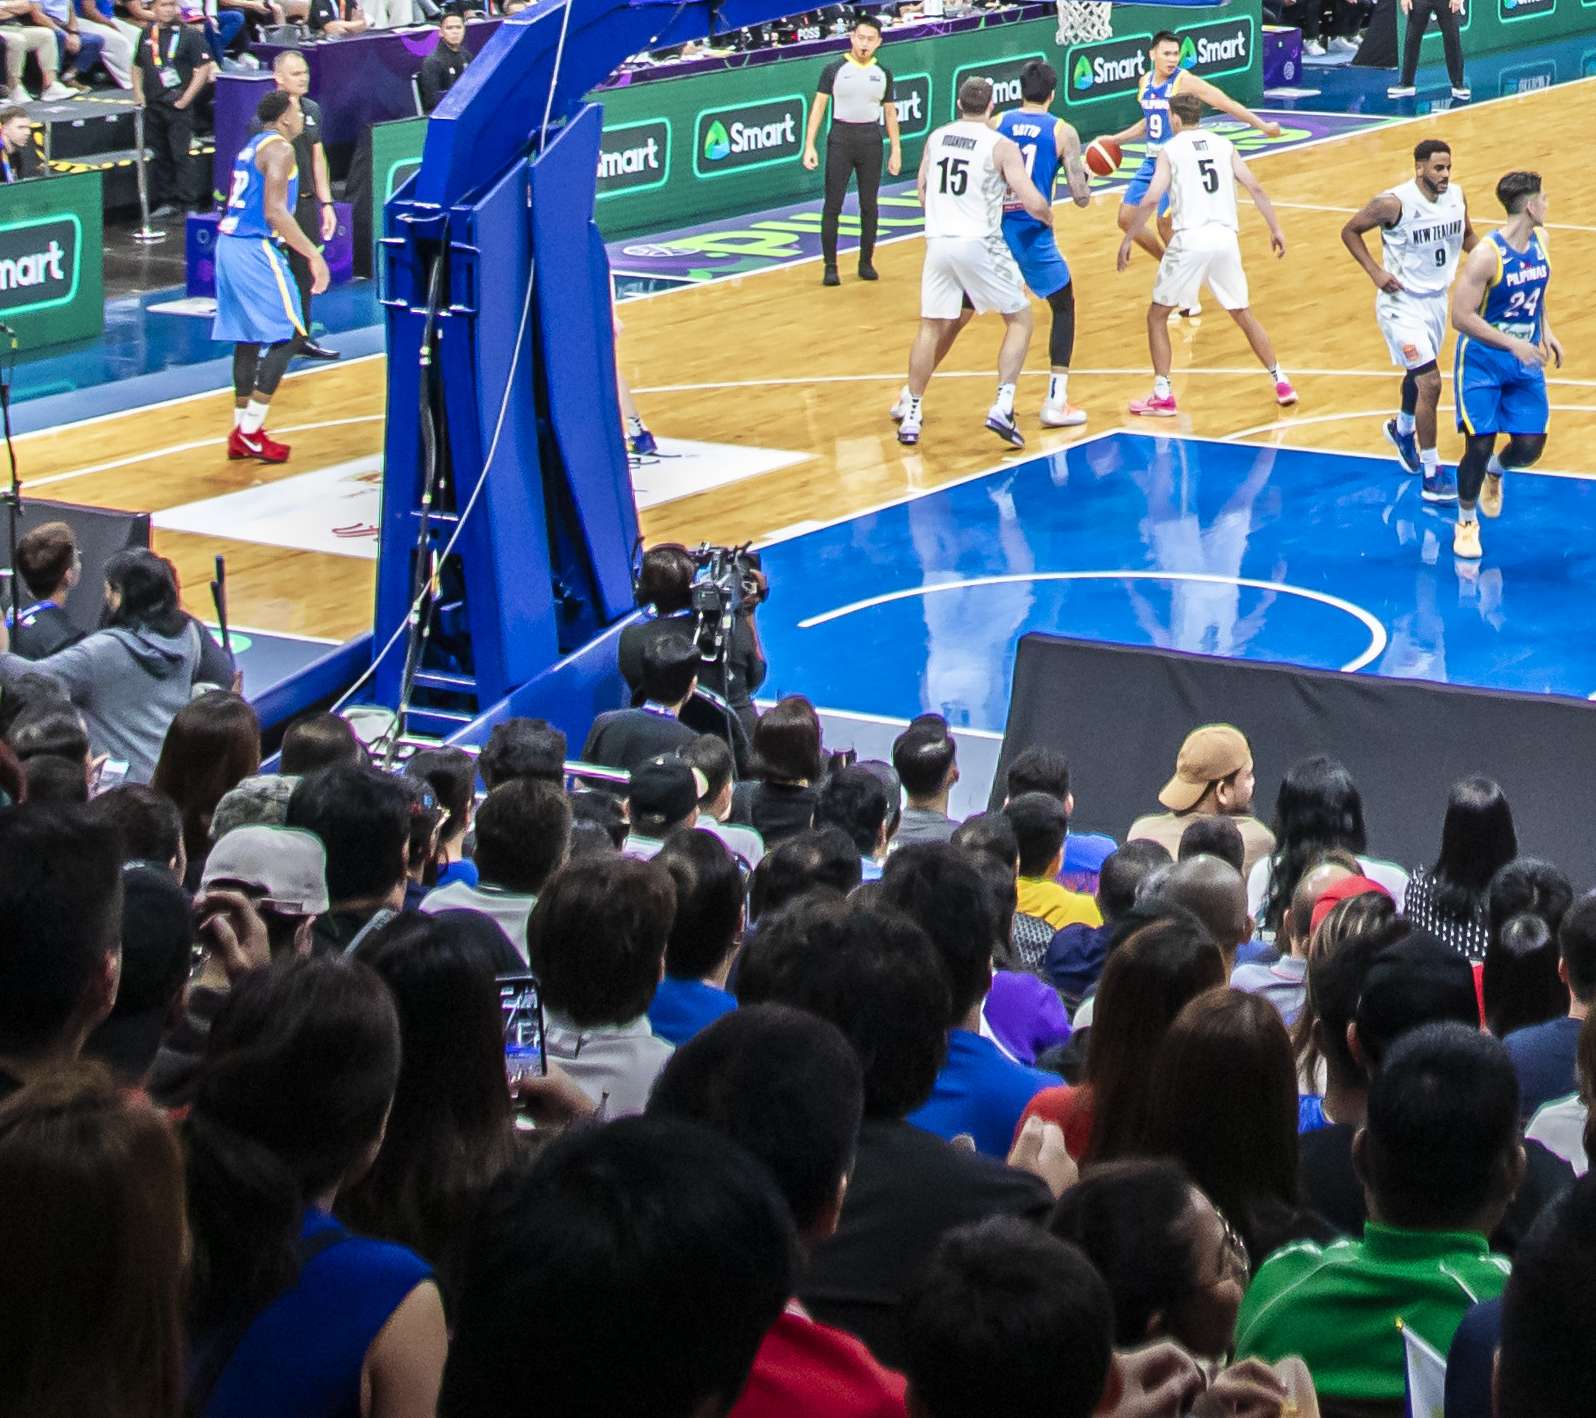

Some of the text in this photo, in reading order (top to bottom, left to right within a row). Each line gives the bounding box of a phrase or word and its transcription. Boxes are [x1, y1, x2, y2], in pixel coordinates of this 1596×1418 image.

[1196, 34, 1247, 64] Smart
[1093, 49, 1146, 85] Smart
[729, 112, 796, 154] Smart
[1148, 113, 1164, 140] 9
[936, 155, 970, 197] 15
[1196, 157, 1220, 195] 5
[1412, 220, 1463, 245] NEW ZEALAND
[1434, 247, 1446, 268] 9
[1505, 263, 1548, 288] PILIPINAS
[1504, 286, 1540, 318] 24
